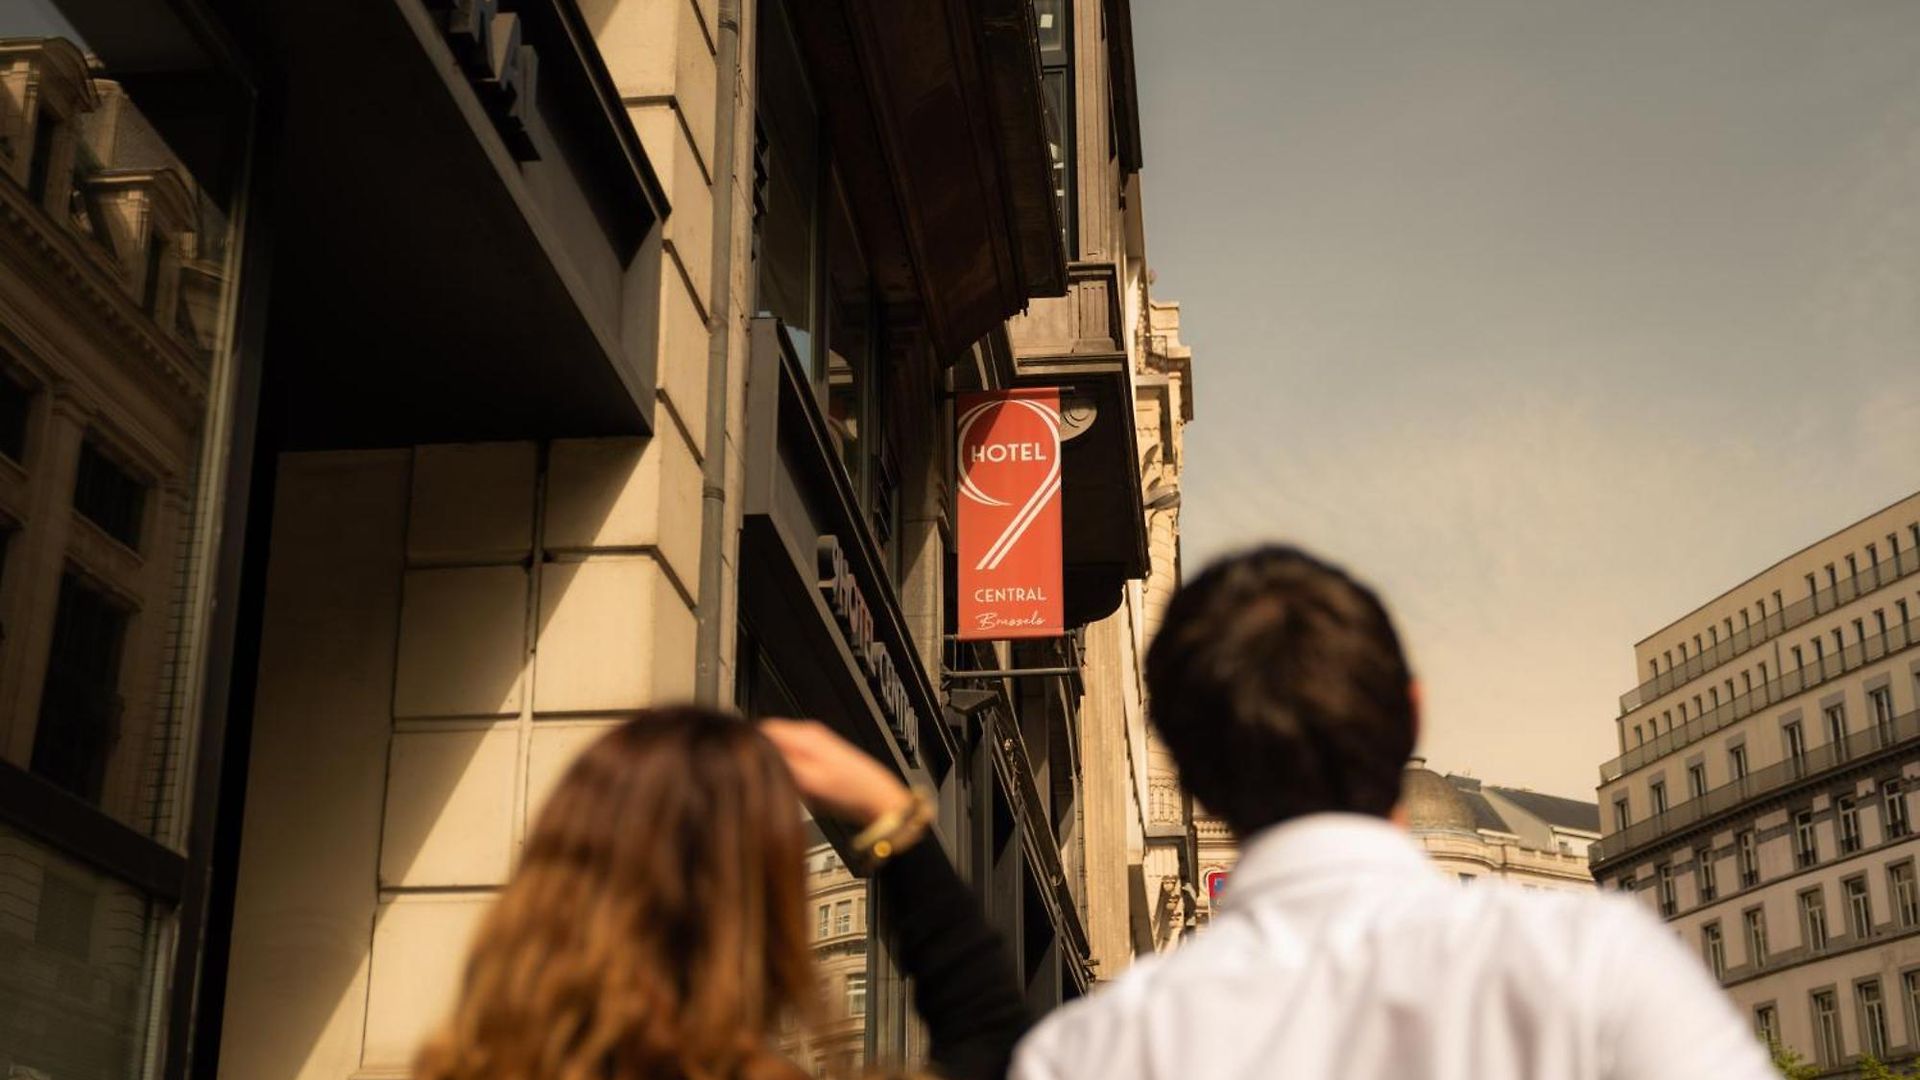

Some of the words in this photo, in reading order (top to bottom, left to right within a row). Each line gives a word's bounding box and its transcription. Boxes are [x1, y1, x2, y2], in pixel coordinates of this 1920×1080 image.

[971, 442, 1047, 463] HOTEL
[974, 586, 1047, 602] CENTRAL
[975, 609, 1046, 630] Brussels
